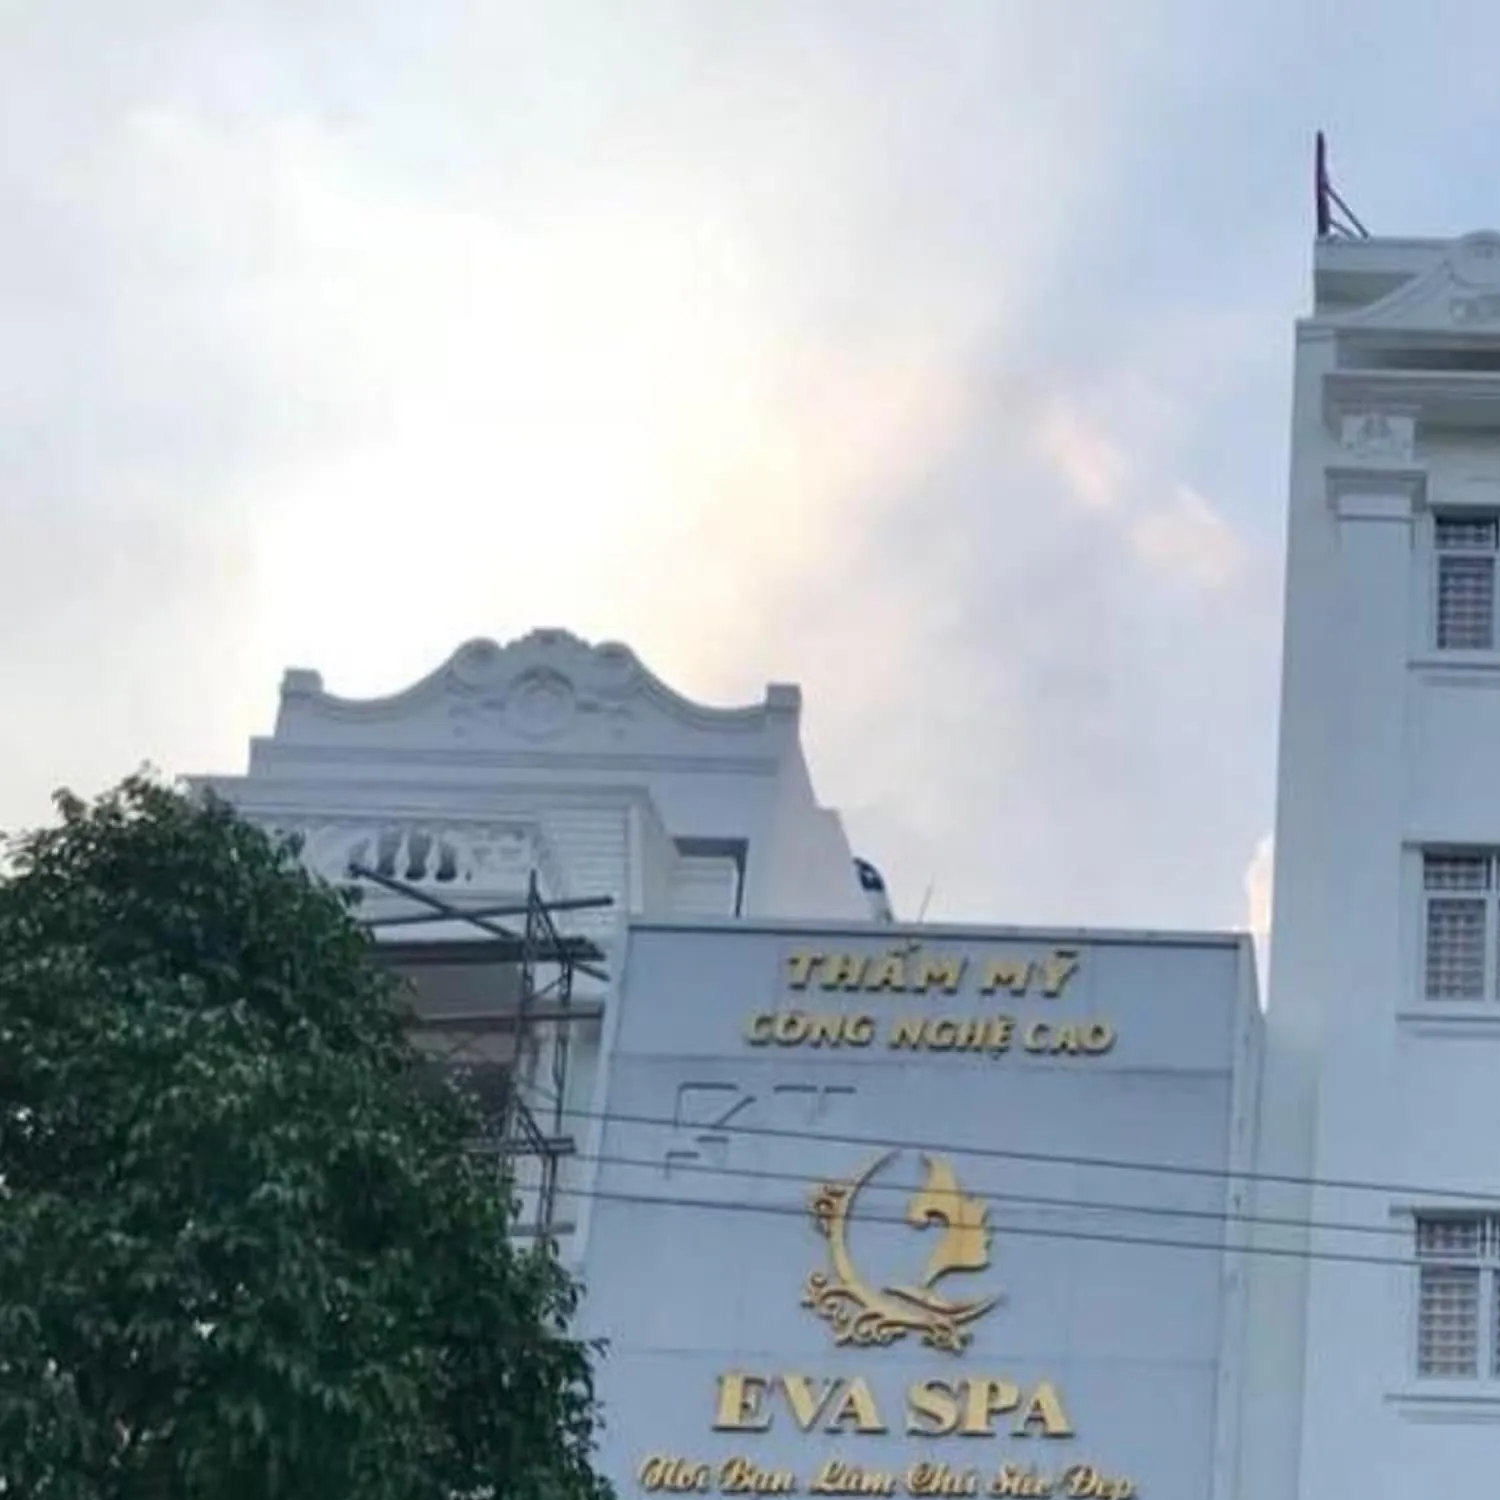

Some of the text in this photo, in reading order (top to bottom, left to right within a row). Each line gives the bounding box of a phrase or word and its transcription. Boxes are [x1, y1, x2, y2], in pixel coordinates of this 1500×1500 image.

[1023, 1020, 1117, 1055] CAO
[712, 1368, 1076, 1439] EVA SPA
